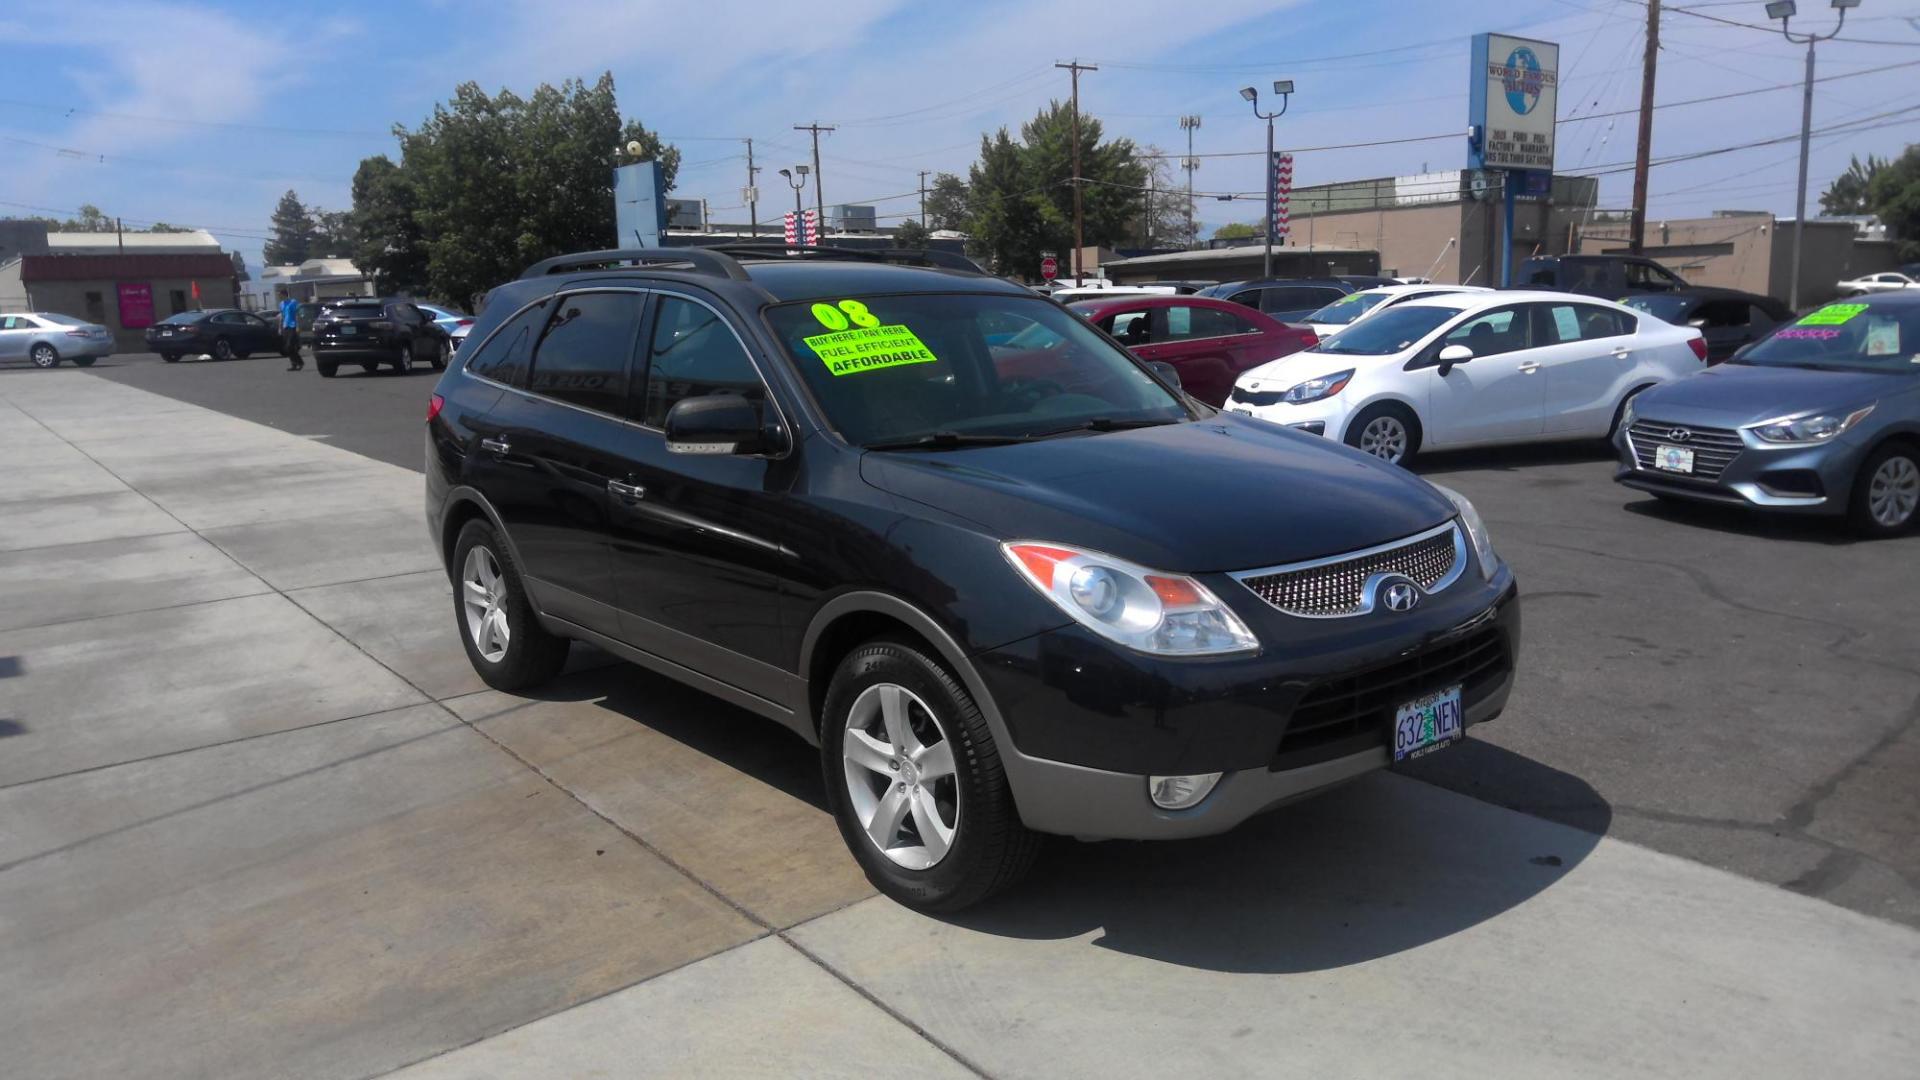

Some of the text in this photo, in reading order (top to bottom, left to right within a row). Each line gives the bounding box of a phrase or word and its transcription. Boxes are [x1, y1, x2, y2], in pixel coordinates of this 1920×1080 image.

[1489, 66, 1556, 83] WORLD FAMOUS
[1488, 141, 1550, 154] FACTORY WARRANTY
[811, 299, 880, 331] 08
[809, 336, 829, 347] BUY
[831, 333, 856, 344] HERE
[863, 329, 881, 339] PAY
[883, 326, 907, 336] HERE
[821, 337, 917, 358] FUEL EFFICIENT
[833, 349, 929, 373] AFFORDABLE
[1397, 699, 1461, 749] 632 NEN
